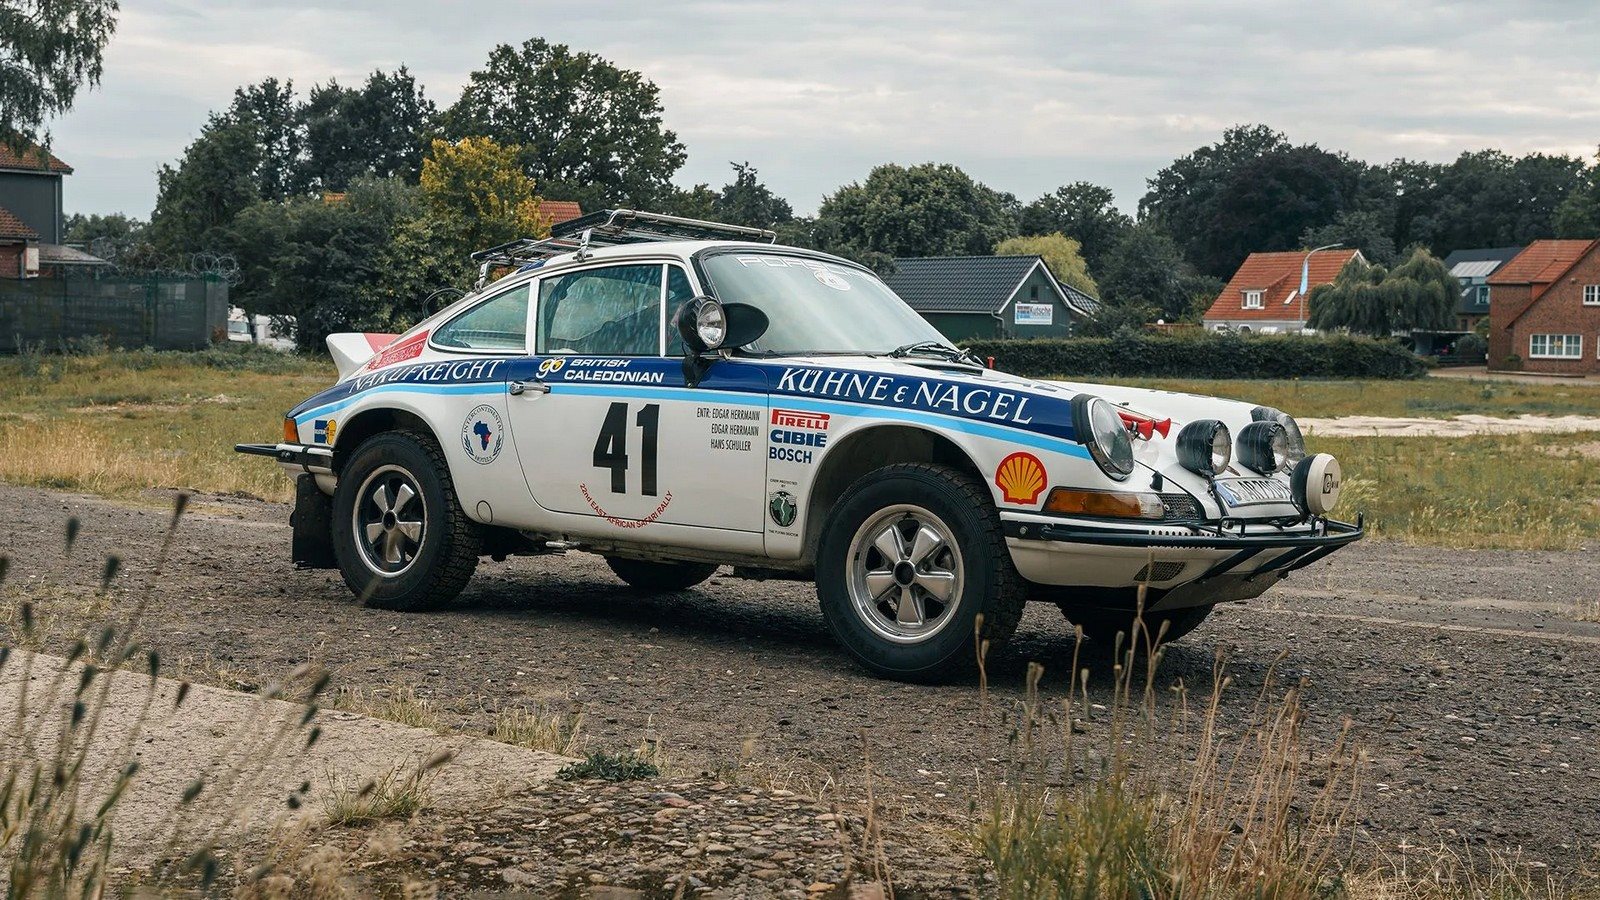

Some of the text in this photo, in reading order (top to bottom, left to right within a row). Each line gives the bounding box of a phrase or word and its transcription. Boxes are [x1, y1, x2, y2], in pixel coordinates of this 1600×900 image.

[570, 358, 631, 368] BRITISH
[348, 359, 506, 394] NAKUFREIGHT
[564, 371, 664, 383] CALEDONIAN
[776, 367, 894, 402] KÜHNE
[911, 380, 1033, 424] NAGEL
[712, 408, 729, 419] EDGAR
[730, 409, 760, 421] HERRMANN
[771, 408, 831, 430] PIRELLI
[711, 423, 759, 436] EDGAR HERRMANN
[592, 402, 660, 497] 41
[710, 438, 725, 450] HANS
[769, 446, 812, 464] BOSCH
[579, 483, 674, 529] 22nd EAST AFRICAN SAFARI RALLY
